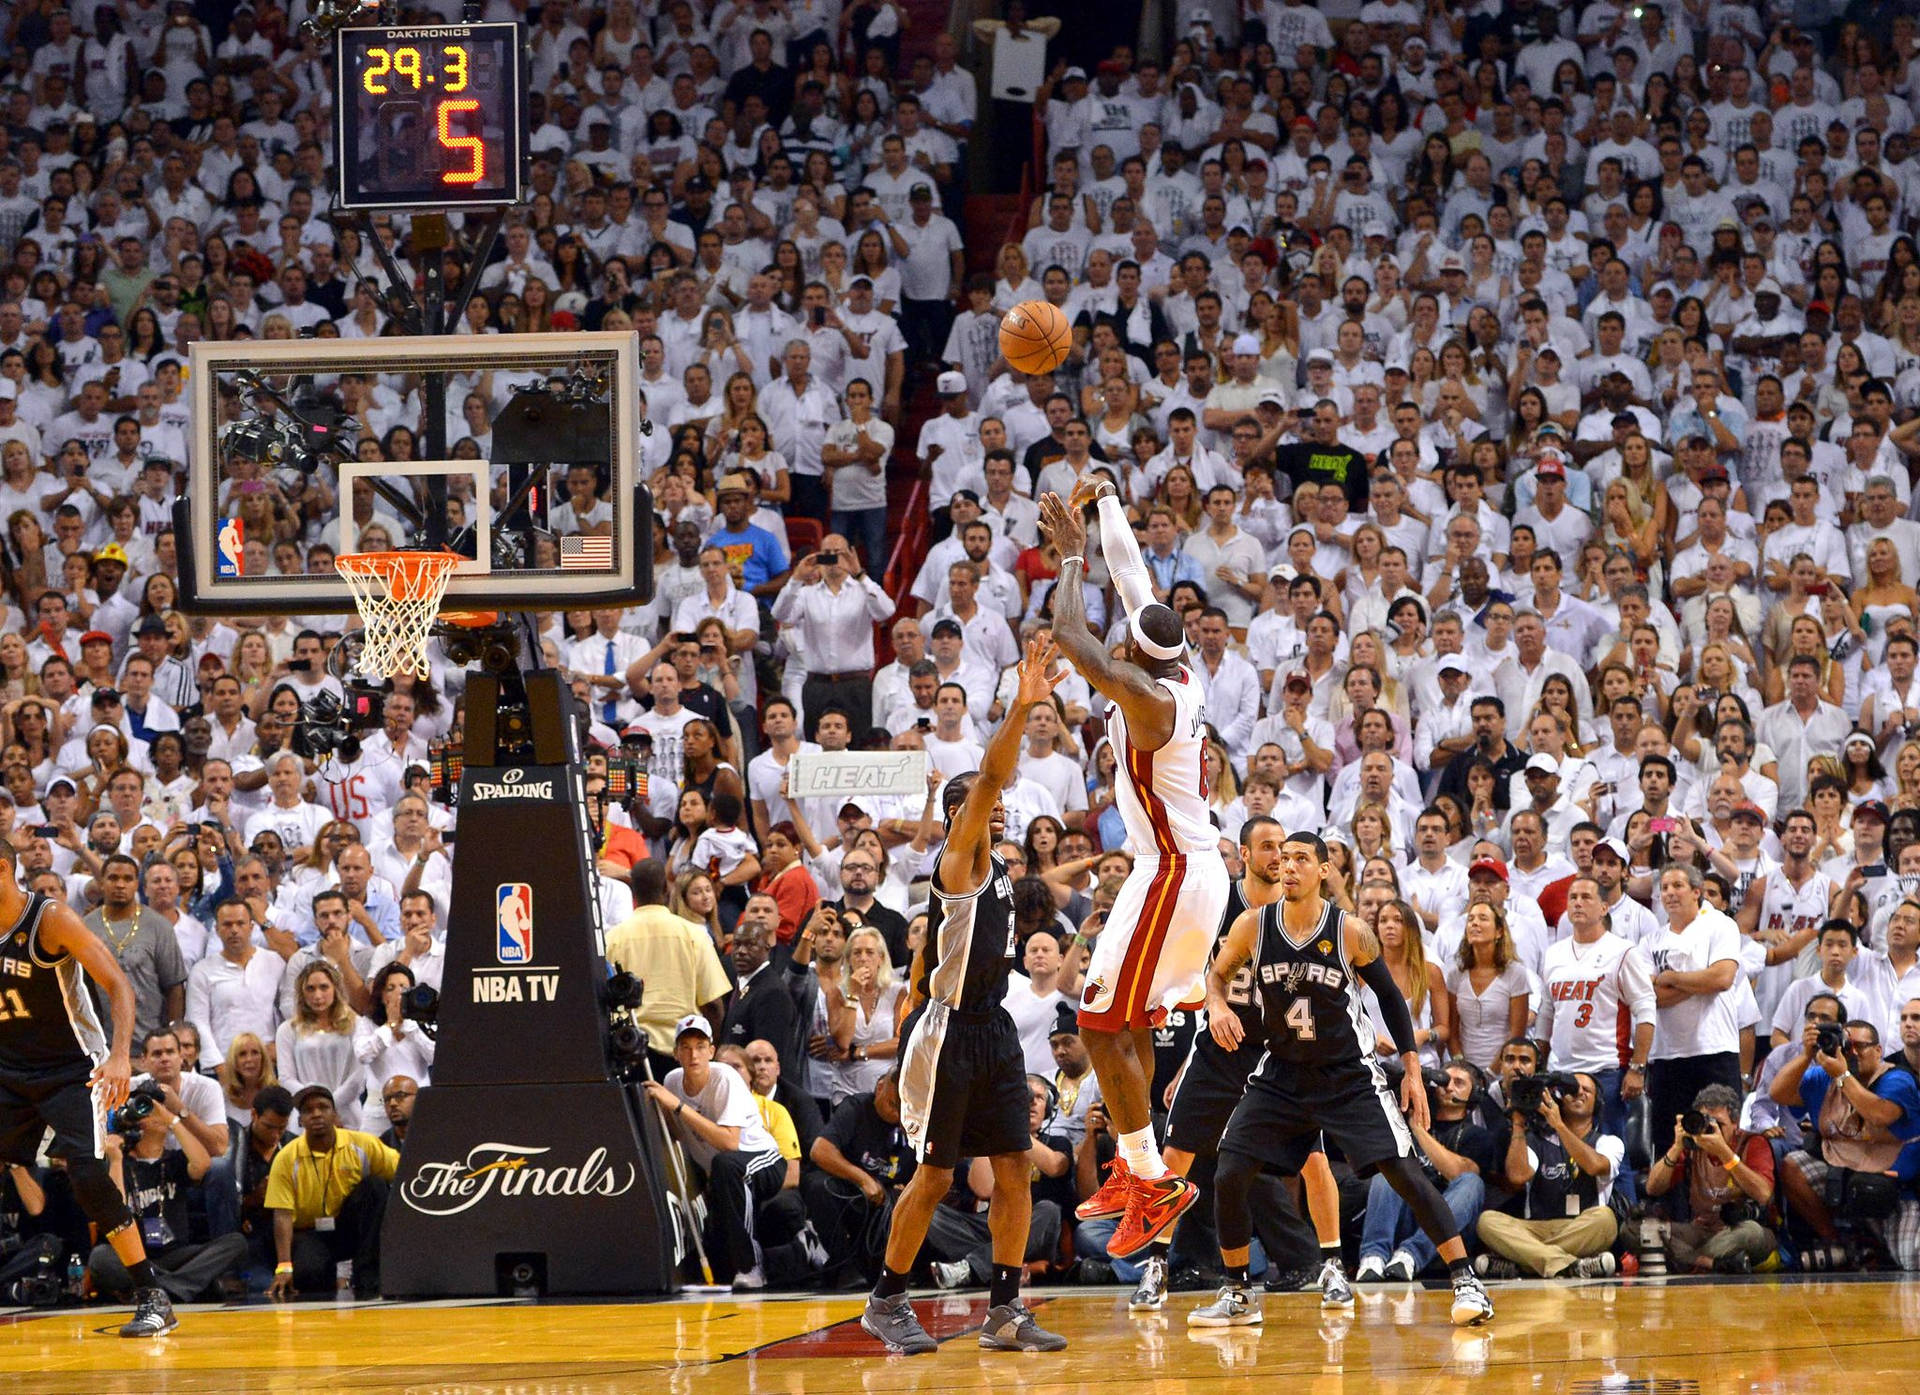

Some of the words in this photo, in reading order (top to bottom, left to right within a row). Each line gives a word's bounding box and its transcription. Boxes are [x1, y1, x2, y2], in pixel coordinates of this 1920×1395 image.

[387, 28, 471, 39] DAKTRONICS
[363, 46, 469, 94] 29.3
[437, 100, 485, 183] 5
[811, 755, 911, 790] HEAT
[472, 781, 554, 801] SPALDING
[1768, 912, 1824, 930] HAT
[501, 946, 522, 957] NBA
[472, 975, 524, 1003] NBA
[526, 975, 560, 1001] TV
[1260, 962, 1344, 994] SPURS
[1551, 974, 1606, 1002] HEAT
[1284, 996, 1317, 1041] 4
[1574, 1003, 1593, 1028] 3
[400, 1142, 636, 1216] Finals
[410, 1160, 477, 1198] The
